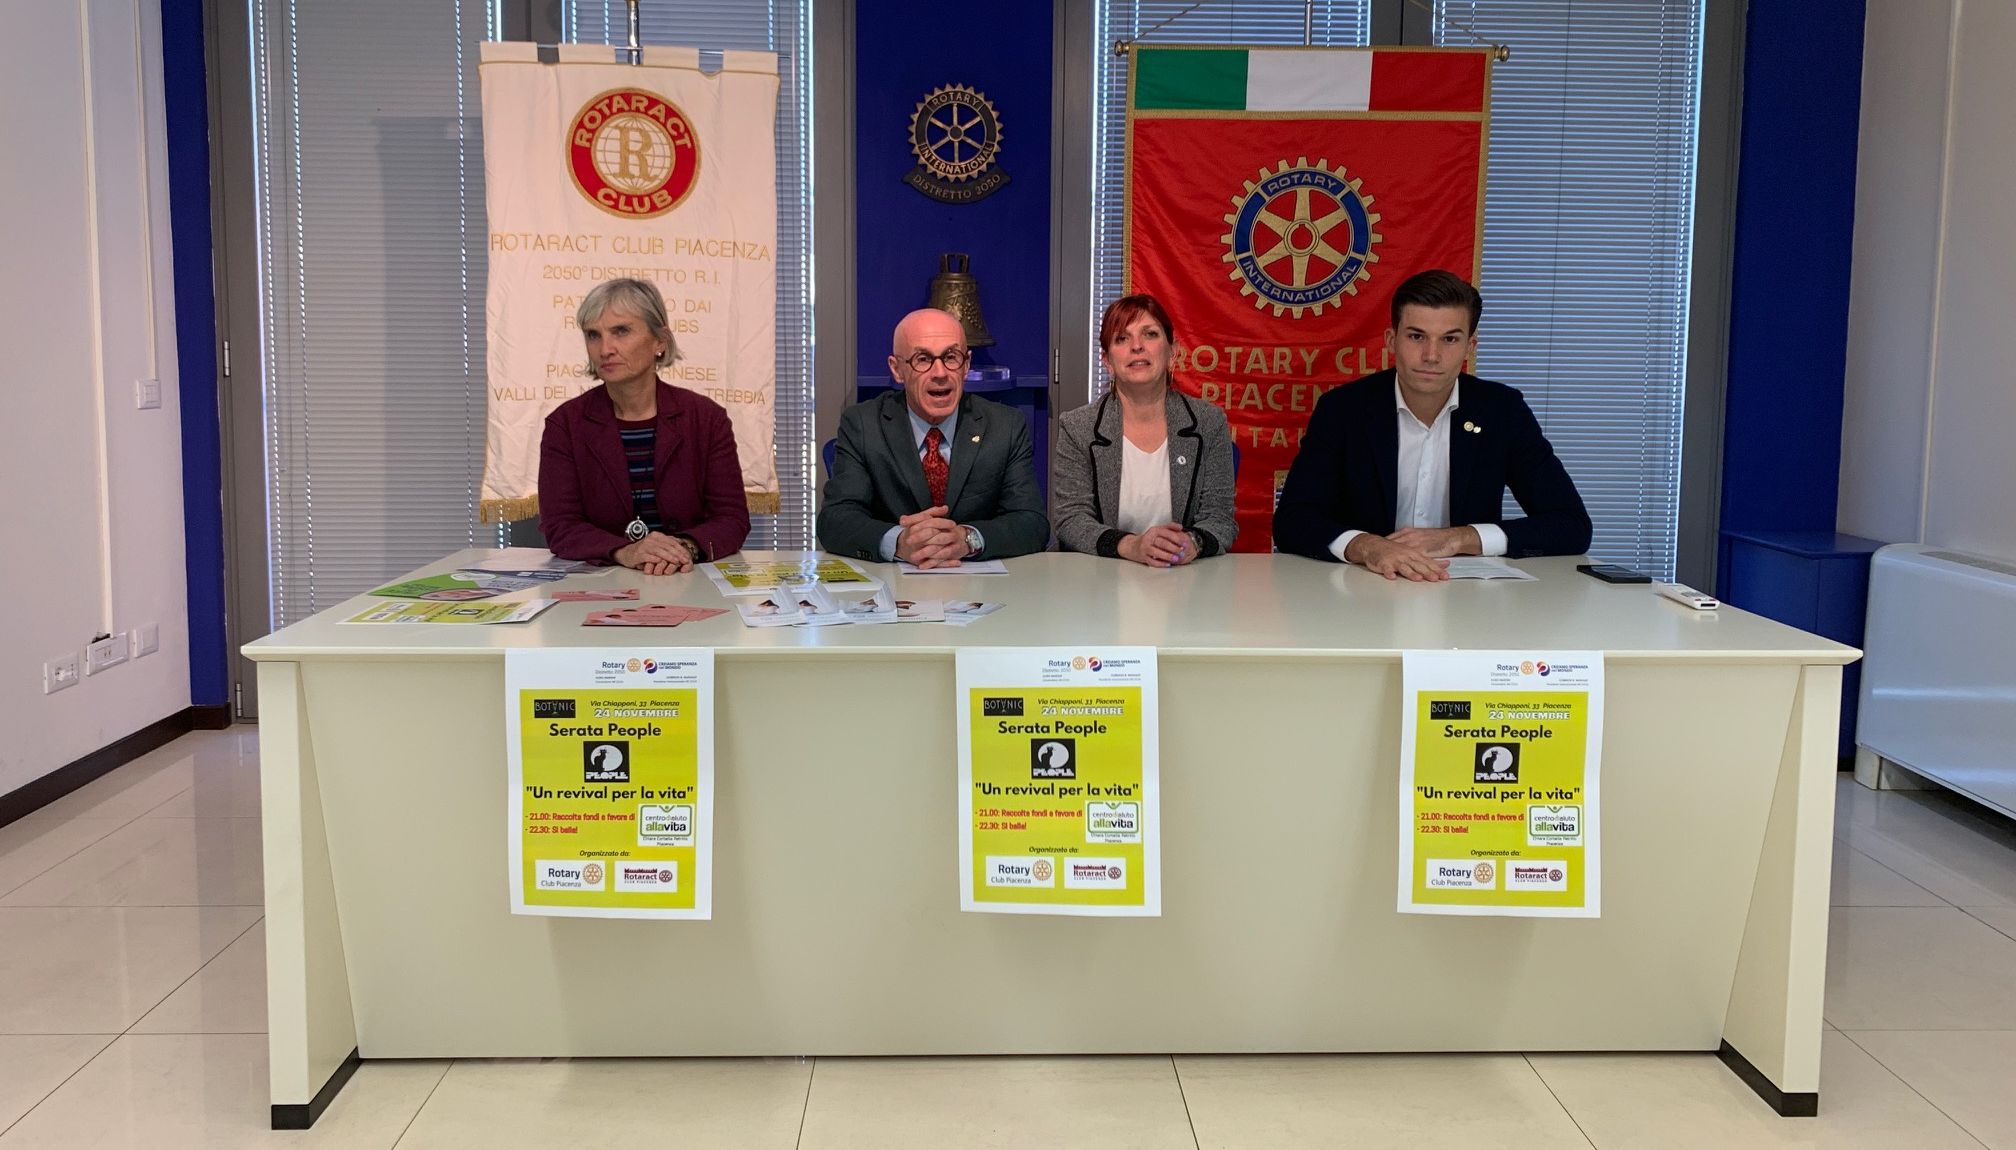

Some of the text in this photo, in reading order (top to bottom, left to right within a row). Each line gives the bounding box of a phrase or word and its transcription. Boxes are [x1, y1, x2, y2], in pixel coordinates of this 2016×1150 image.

[932, 91, 981, 107] ROTARY
[575, 95, 693, 149] ROTARACT
[920, 143, 995, 175] INTERNATIONAL
[912, 173, 1001, 200] DISTRETTO 2050
[1267, 173, 1337, 194] ROTARY
[597, 187, 673, 213] CLUB
[491, 233, 770, 262] ROTARACT CLUB PIACENZA
[591, 266, 687, 284] DISTRETTO
[1242, 260, 1358, 302] INTERNATIONAL
[685, 300, 712, 314] DAI
[494, 386, 536, 401] VALLI
[544, 385, 569, 400] DEL
[704, 387, 766, 405] TREBBIA
[602, 661, 625, 670] Rotary
[1049, 660, 1071, 668] Rotary
[1496, 664, 1519, 672] Rotary
[594, 708, 679, 718] 24 NOVEMBRE
[1041, 706, 1124, 715] 24 NOVEMBRE
[1489, 710, 1570, 720] 24 NOVEMBRE
[549, 722, 662, 740] Serata People
[998, 720, 1107, 737] Serata People
[1444, 724, 1553, 741] Serata People
[526, 786, 693, 802] "Un revival per la vita"
[975, 783, 1138, 798] "Un revival per la vita"
[1417, 786, 1580, 802] "Un revival per la vita"
[529, 813, 551, 821] 21.00:
[628, 813, 636, 821] di
[979, 809, 999, 817] 21.00:
[1076, 809, 1083, 817] di
[1421, 813, 1441, 821] 21.00:
[1518, 813, 1524, 821] di
[529, 826, 550, 834] 22.30:
[979, 822, 999, 830] 22.30:
[579, 850, 619, 858] Organizzato
[1029, 846, 1067, 854] Organizzato
[548, 868, 580, 880] Rotary
[624, 872, 657, 880] Rotaract
[998, 864, 1030, 876] Rotary
[1073, 869, 1106, 877] Rotaract
[1439, 867, 1472, 879] Rotary
[556, 880, 582, 888] Piacenza
[1006, 876, 1032, 884] Piacenza
[1446, 879, 1472, 887] Piacenza
